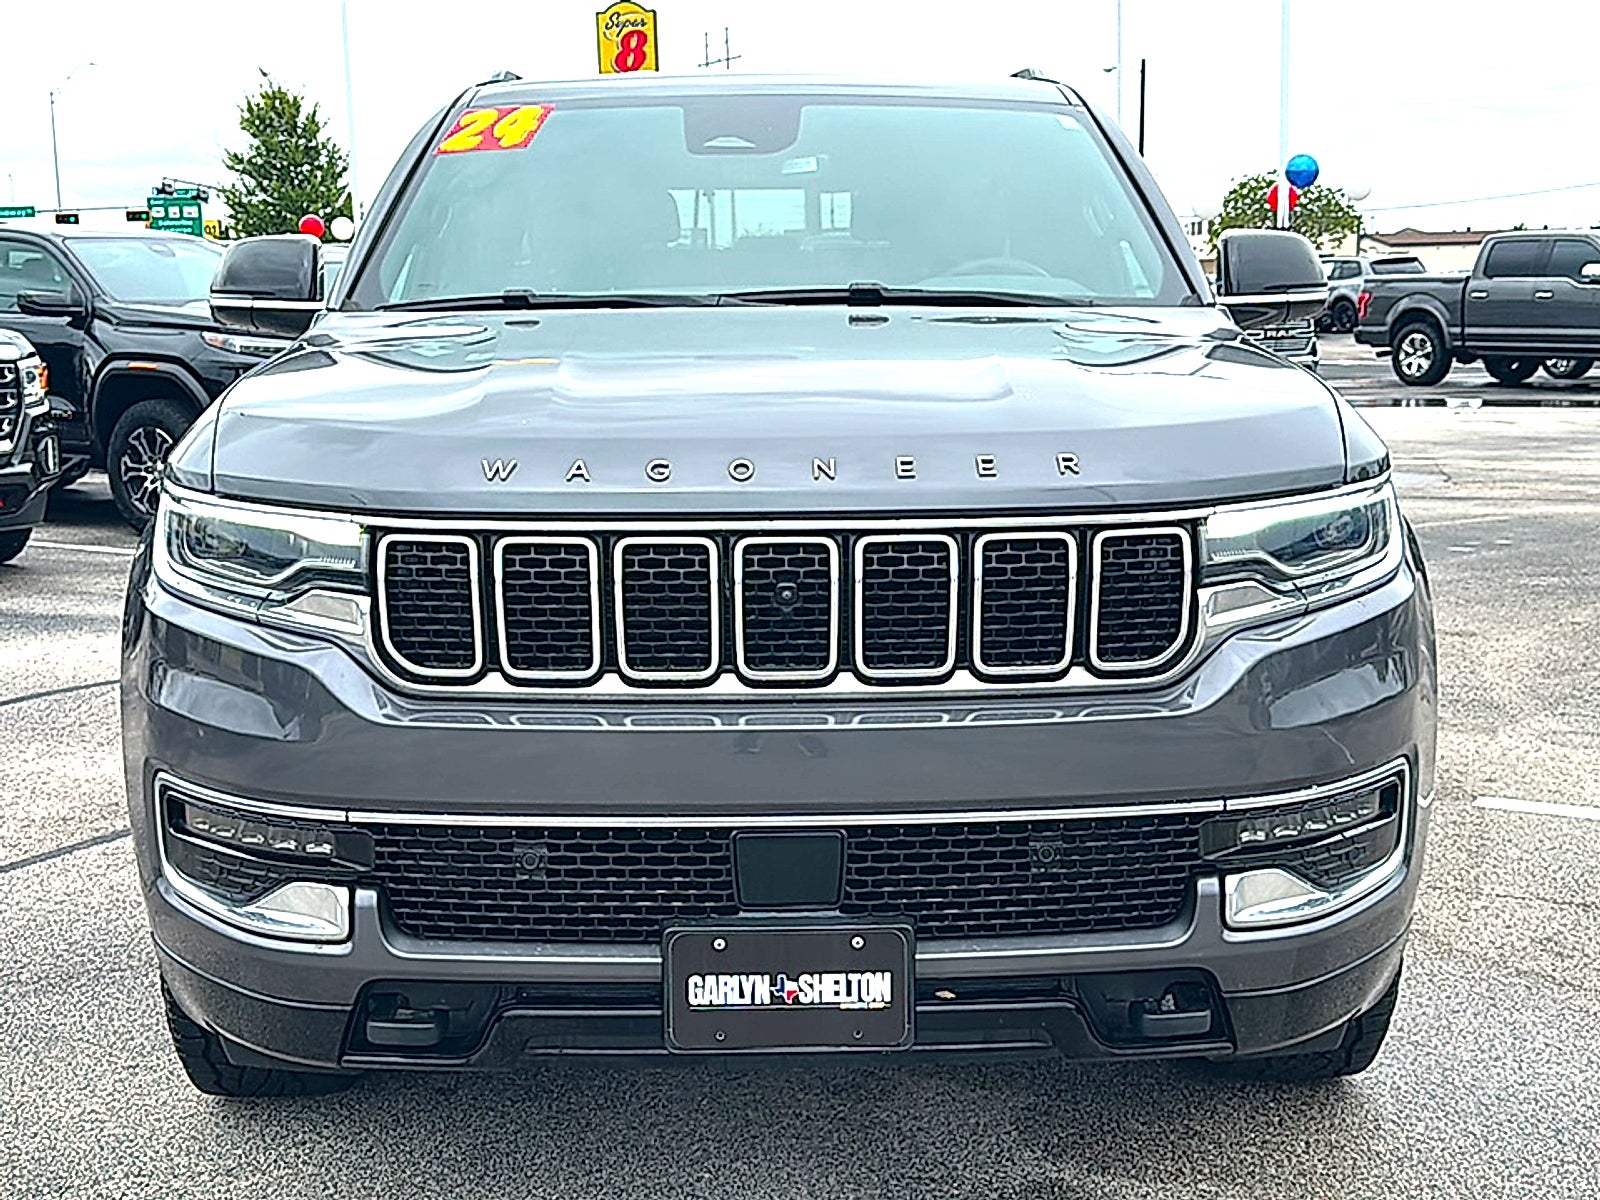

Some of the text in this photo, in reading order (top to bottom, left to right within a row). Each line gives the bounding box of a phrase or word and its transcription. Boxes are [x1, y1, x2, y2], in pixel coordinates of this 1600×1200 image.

[605, 11, 648, 38] Super
[614, 29, 648, 72] 8
[440, 105, 544, 152] 24
[480, 452, 1081, 482] WAGONEER
[688, 971, 892, 1006] GARLYN SHELTON
